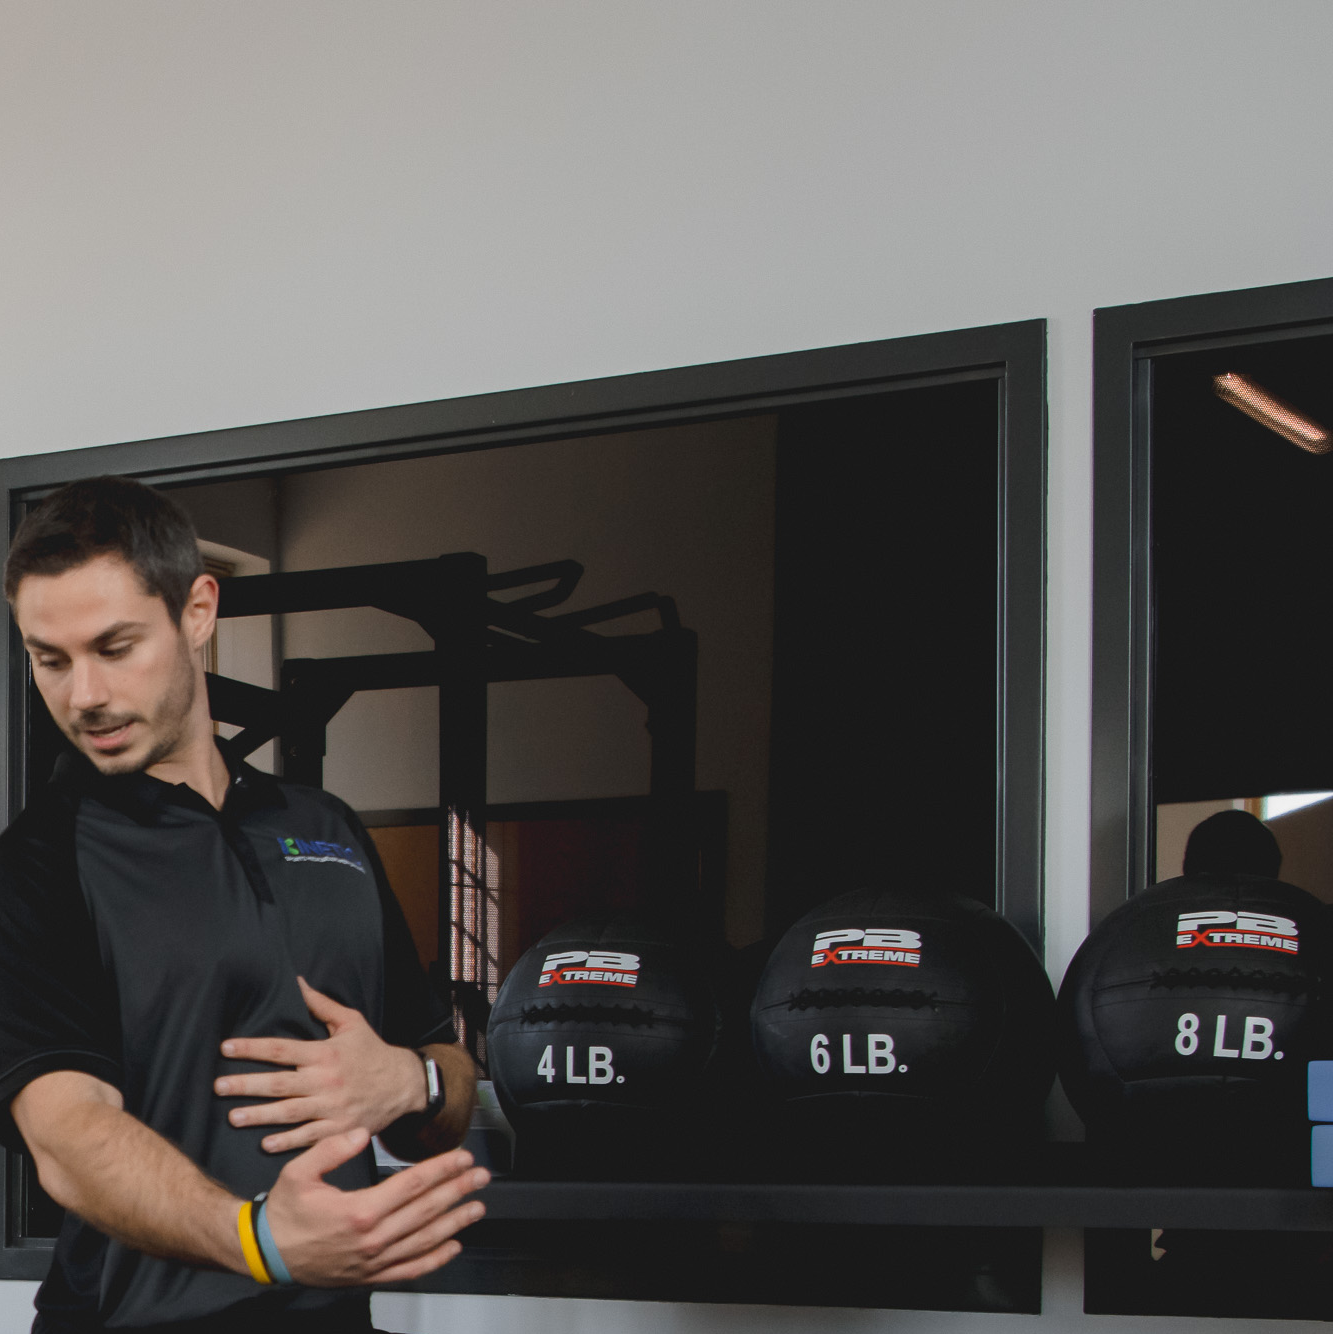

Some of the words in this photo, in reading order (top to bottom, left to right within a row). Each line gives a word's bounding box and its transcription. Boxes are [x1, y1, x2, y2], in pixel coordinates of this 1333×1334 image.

[277, 837, 362, 866] KINET
[1177, 910, 1299, 936] PB
[813, 928, 922, 951] PB
[542, 950, 640, 972] PB
[1174, 1012, 1200, 1056] 8
[1213, 1014, 1285, 1060] LB.
[537, 1044, 556, 1083] 4
[566, 1045, 626, 1085] LB.
[810, 1033, 831, 1074] 6
[842, 1033, 909, 1075] LB.
